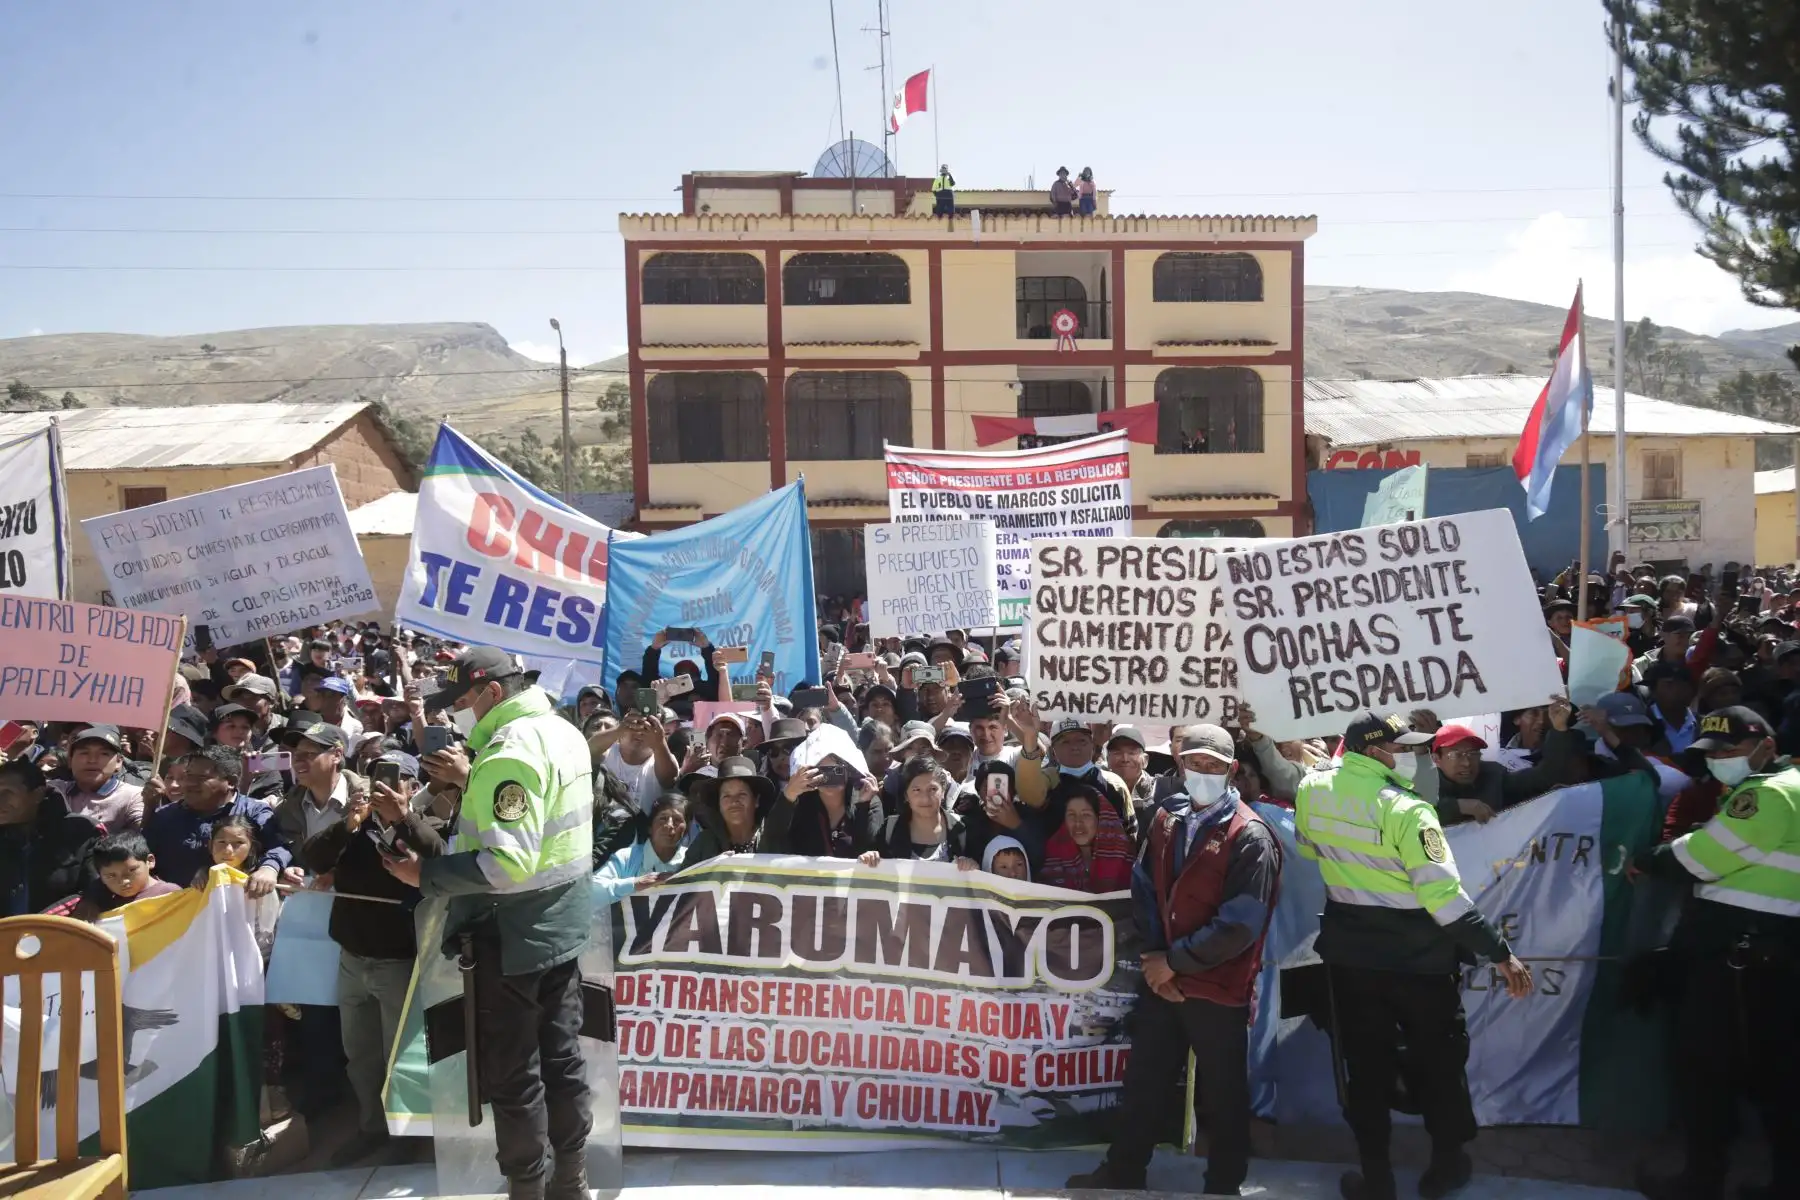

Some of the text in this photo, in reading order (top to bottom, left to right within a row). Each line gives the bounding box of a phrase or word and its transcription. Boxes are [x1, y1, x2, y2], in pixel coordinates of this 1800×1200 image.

[940, 474, 1012, 487] PRESIDENTE
[1017, 472, 1033, 485] DE
[1036, 470, 1052, 484] LA
[238, 480, 335, 515] RESPALDAMOS
[901, 483, 1121, 509] EL PUEBLO DE MARGOS SOLICITA
[0, 498, 37, 541] NTO
[1060, 511, 1067, 525] Y
[1070, 505, 1131, 525] ASFALTADO
[902, 522, 988, 543] PRESIDENTE
[996, 533, 1019, 545] ERA
[877, 546, 979, 574] PRESUPUESTO
[1097, 545, 1220, 581] PRESID
[1227, 551, 1273, 584] NO
[1378, 520, 1461, 562] SOLO
[224, 564, 257, 583] AGUA
[418, 551, 481, 616] TE
[907, 569, 978, 594] URGENTE
[1, 597, 74, 634] ENTRO
[202, 608, 220, 622] DE
[681, 588, 734, 621] GESTIÓN
[882, 596, 918, 616] PARA
[925, 594, 951, 612] LAS
[1036, 584, 1197, 617] QUEREMOS
[1233, 585, 1284, 620] SR.
[246, 604, 320, 632] APROBADO
[897, 607, 996, 635] ENCAMINADAS
[1037, 617, 1194, 653] CIAMIENTO
[1243, 603, 1473, 674] COCHAS TE
[59, 643, 92, 668] DE
[1039, 655, 1239, 689] NUESTRO SER
[0, 666, 144, 707] PACAYHUA
[1288, 650, 1488, 719] RESPALDA
[1036, 690, 1210, 719] SANEAMIENTO
[628, 891, 1104, 982] YARUMAYO
[615, 974, 1072, 1041] DE TRANSFERENCIA DE AGUA Y
[618, 1019, 656, 1057] TO
[664, 1023, 702, 1059] DE
[710, 1025, 767, 1061] LAS
[773, 1028, 981, 1080] LOCALIDADES
[988, 1050, 1026, 1088] DE
[619, 1070, 997, 1128] AMPAMARCA Y CHULLAY.
